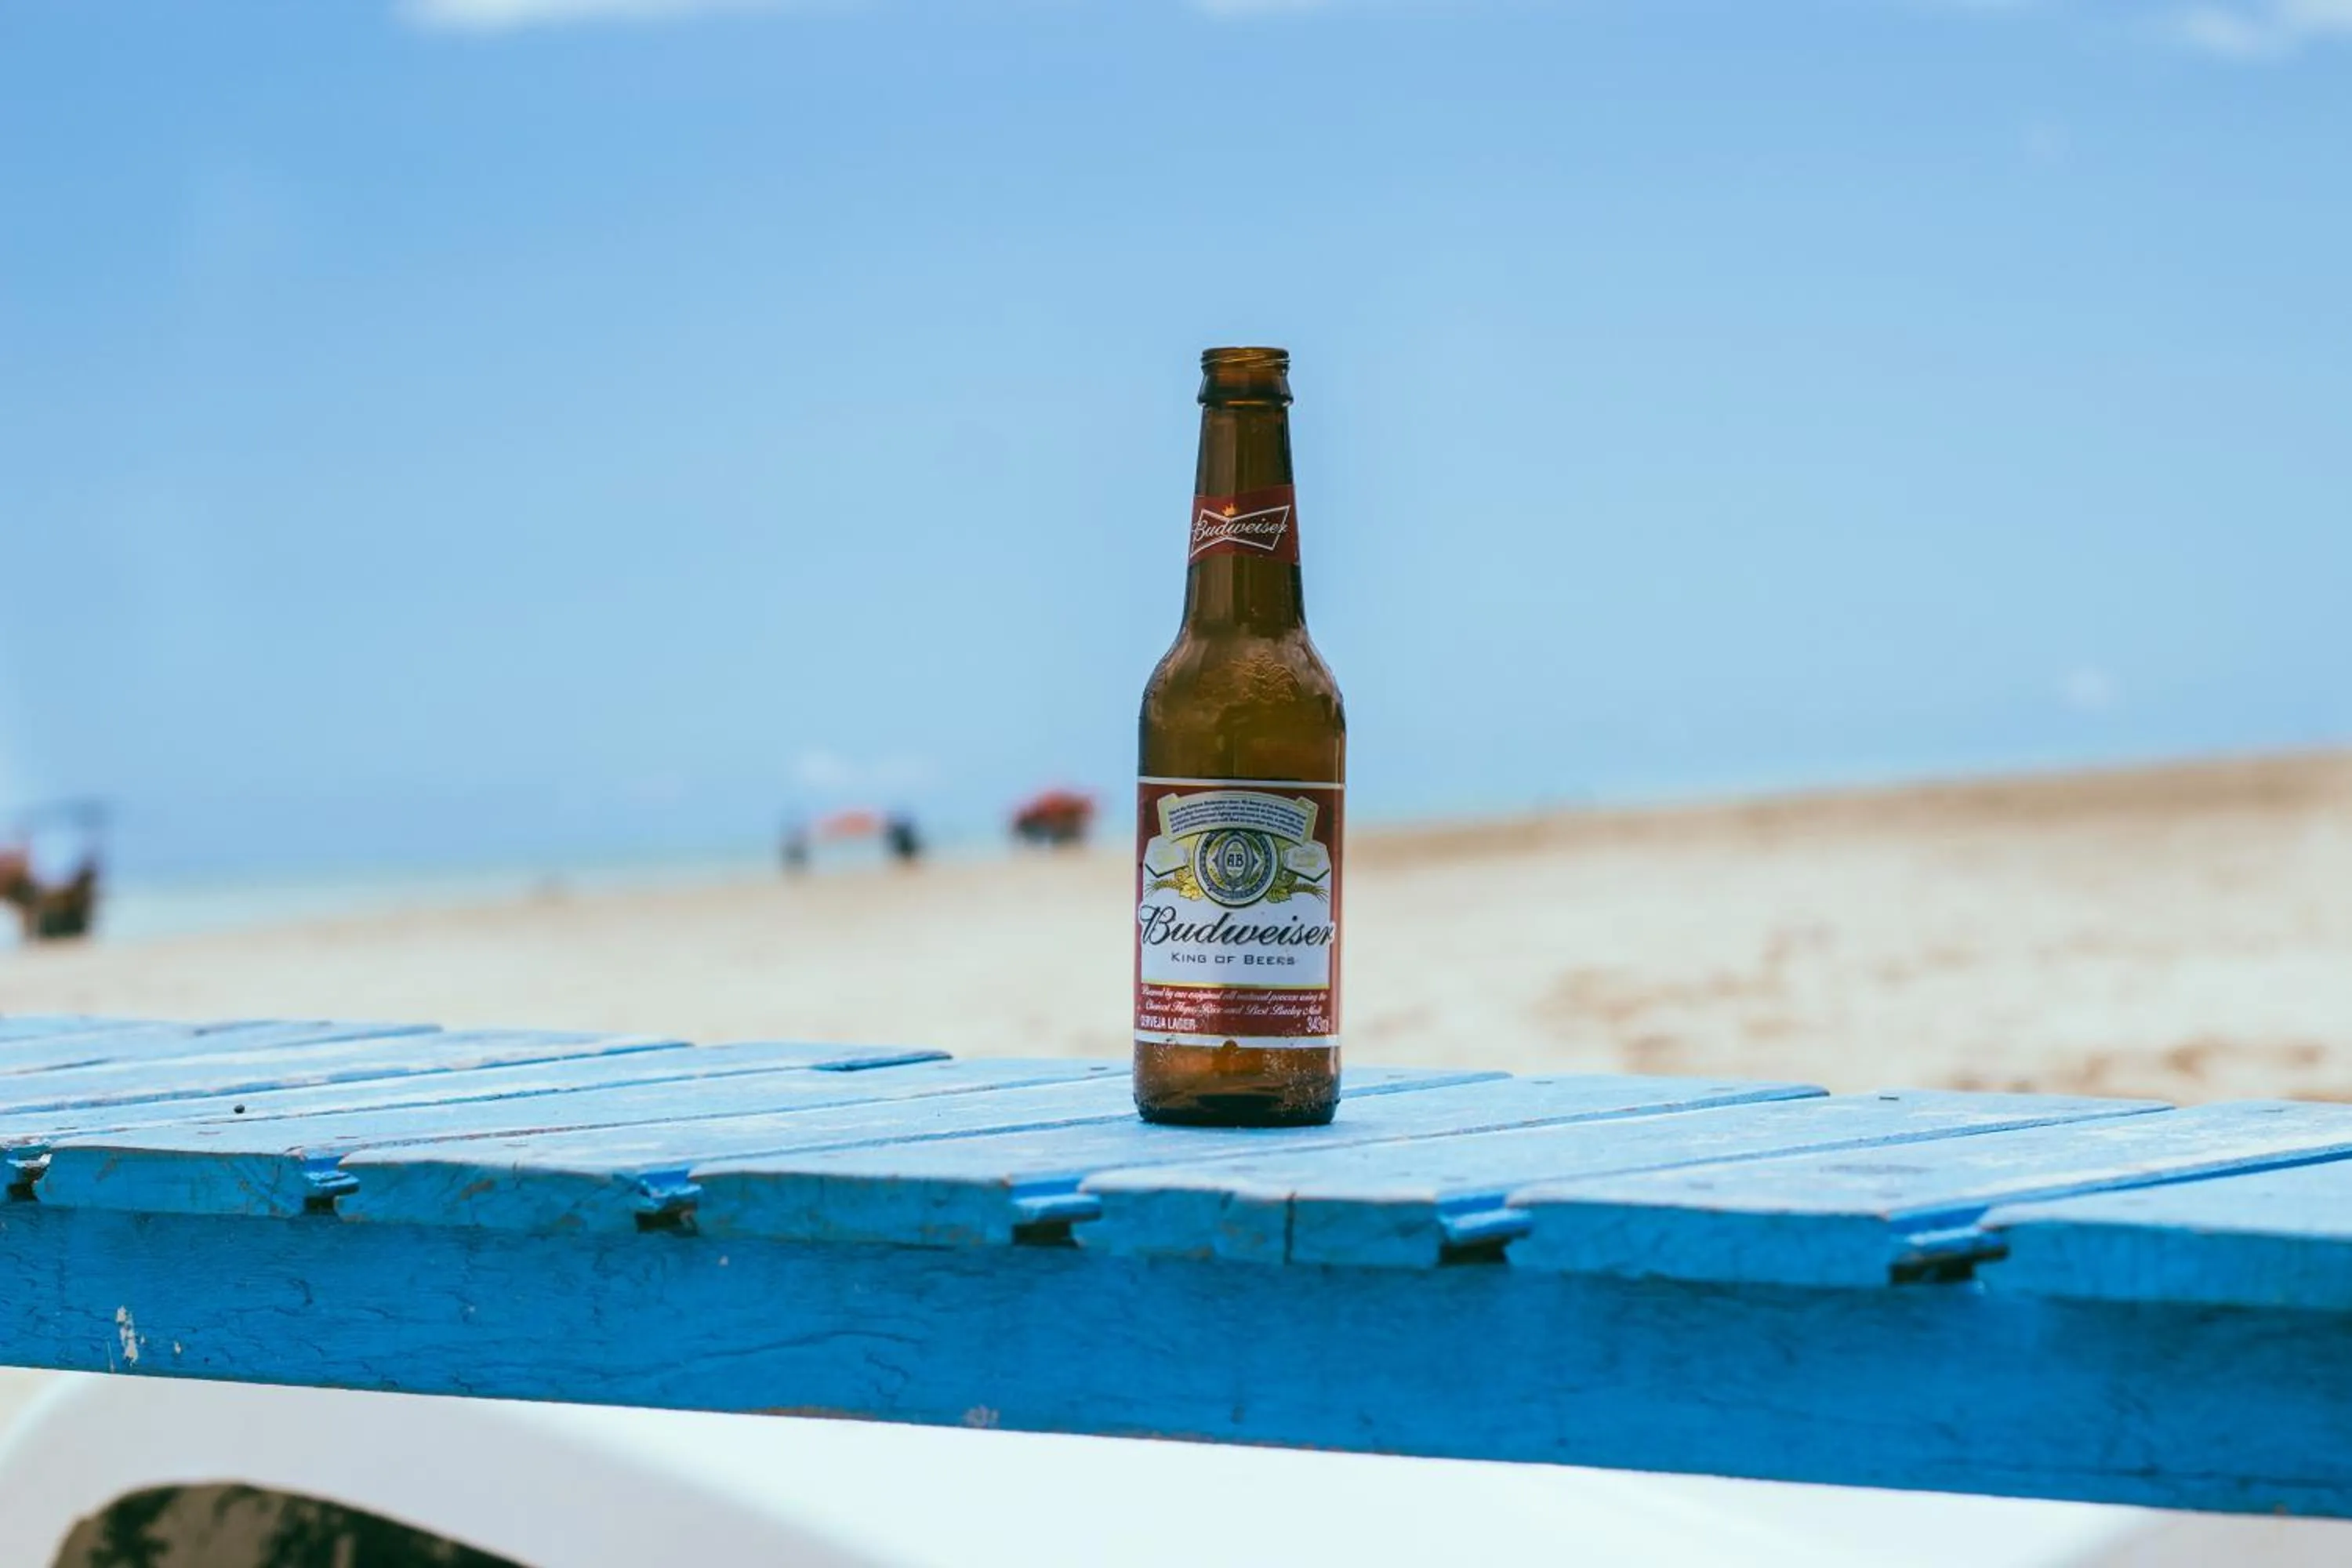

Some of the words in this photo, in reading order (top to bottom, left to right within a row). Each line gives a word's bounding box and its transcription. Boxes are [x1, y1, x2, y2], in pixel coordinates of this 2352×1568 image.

[1192, 517, 1288, 543] Budweiser
[1140, 906, 1334, 946] Budweiser
[1167, 1016, 1196, 1031] LAGER
